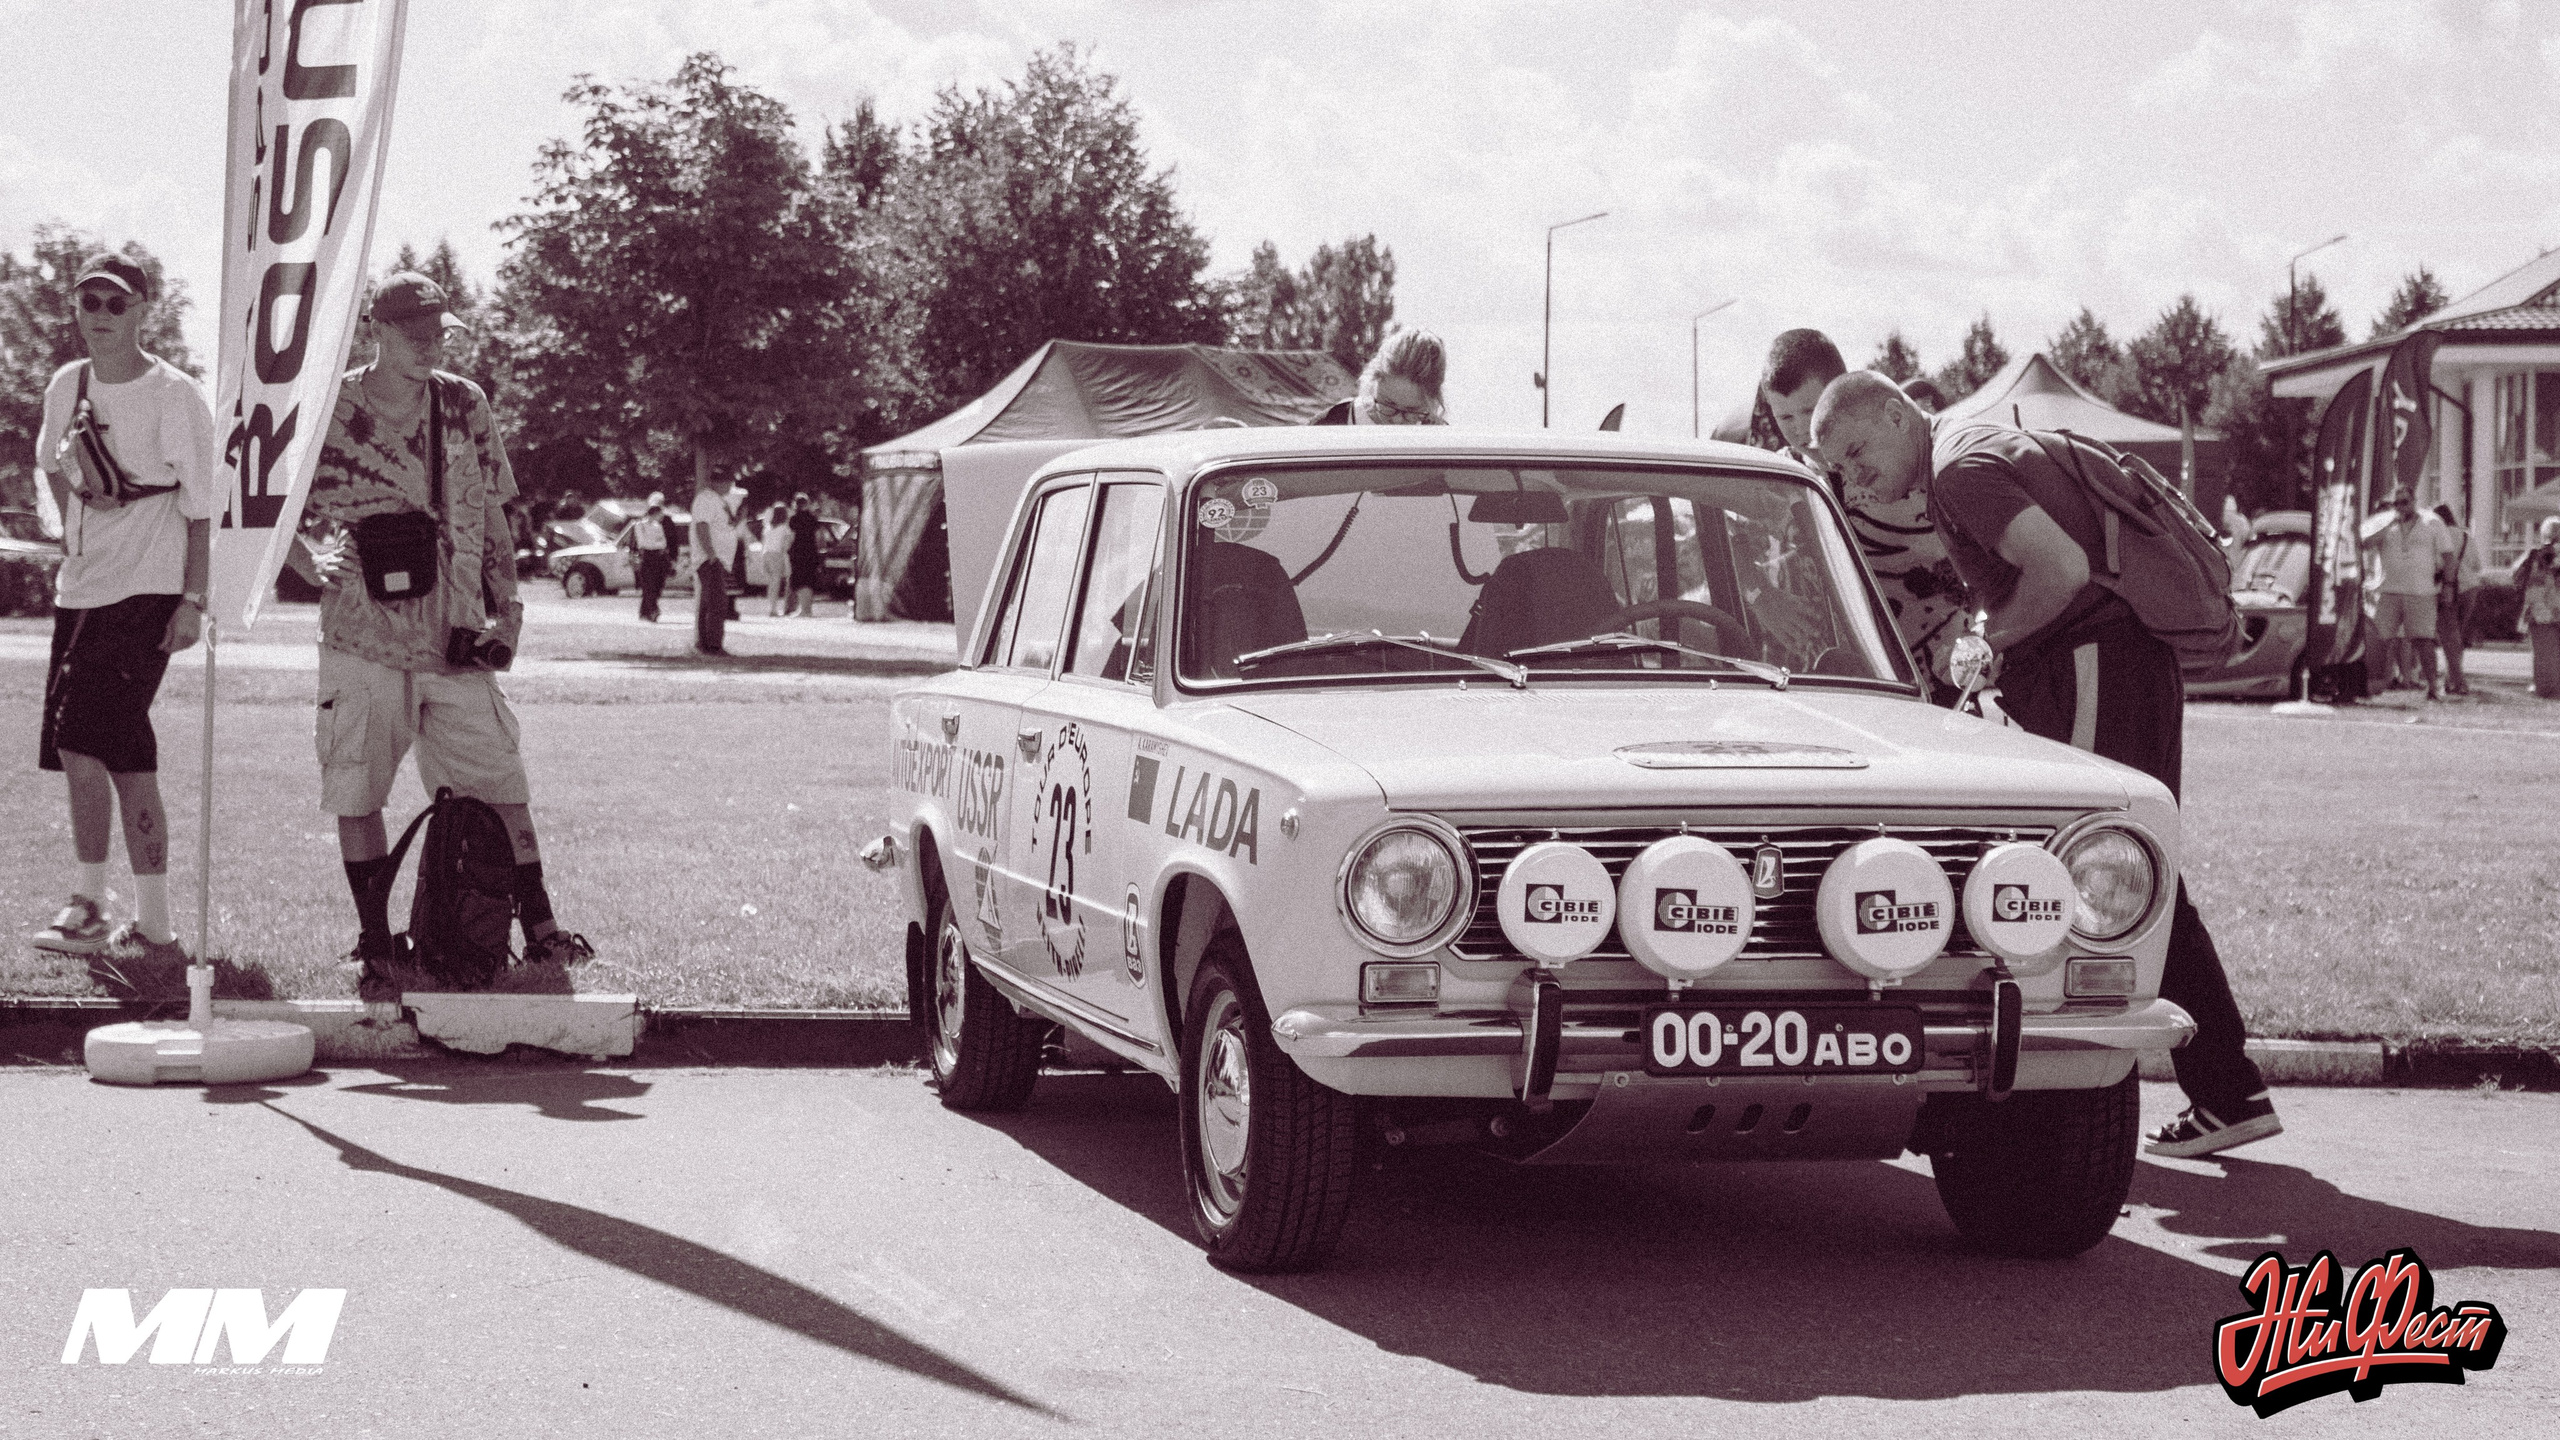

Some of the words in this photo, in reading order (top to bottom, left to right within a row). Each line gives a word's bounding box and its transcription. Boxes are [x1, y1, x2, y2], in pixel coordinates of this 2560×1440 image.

[1252, 486, 1267, 497] 23
[1208, 507, 1226, 518] 92
[957, 747, 1004, 841] USSR
[1165, 765, 1260, 865] LADA
[1046, 783, 1077, 926] 23
[1564, 915, 1599, 923] IODE
[1697, 924, 1738, 934] IODE
[1898, 920, 1940, 932] IODE
[1652, 1010, 1809, 1068] 00-20
